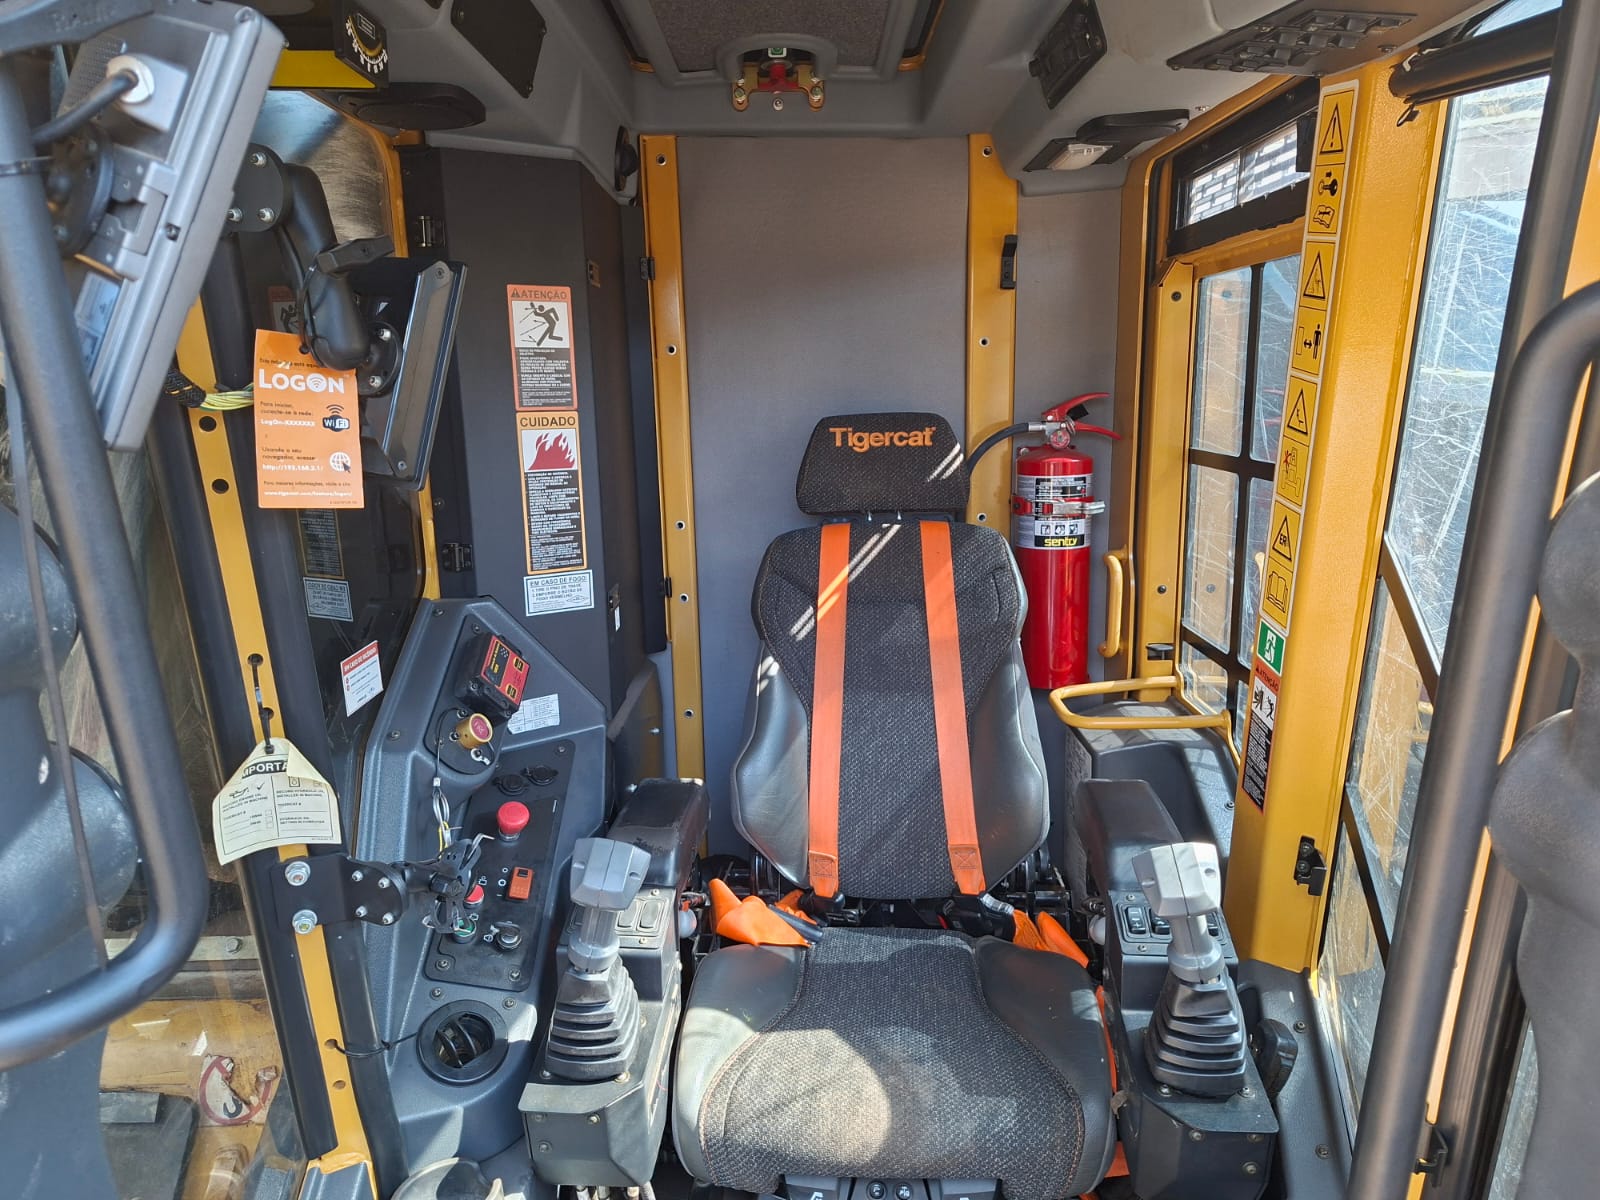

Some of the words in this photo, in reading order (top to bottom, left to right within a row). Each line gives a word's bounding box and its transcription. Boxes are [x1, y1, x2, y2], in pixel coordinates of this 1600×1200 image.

[258, 368, 345, 394] LOGON
[519, 416, 576, 427] CUIDADO
[829, 427, 934, 453] Tigercat
[1044, 536, 1078, 547] sentry
